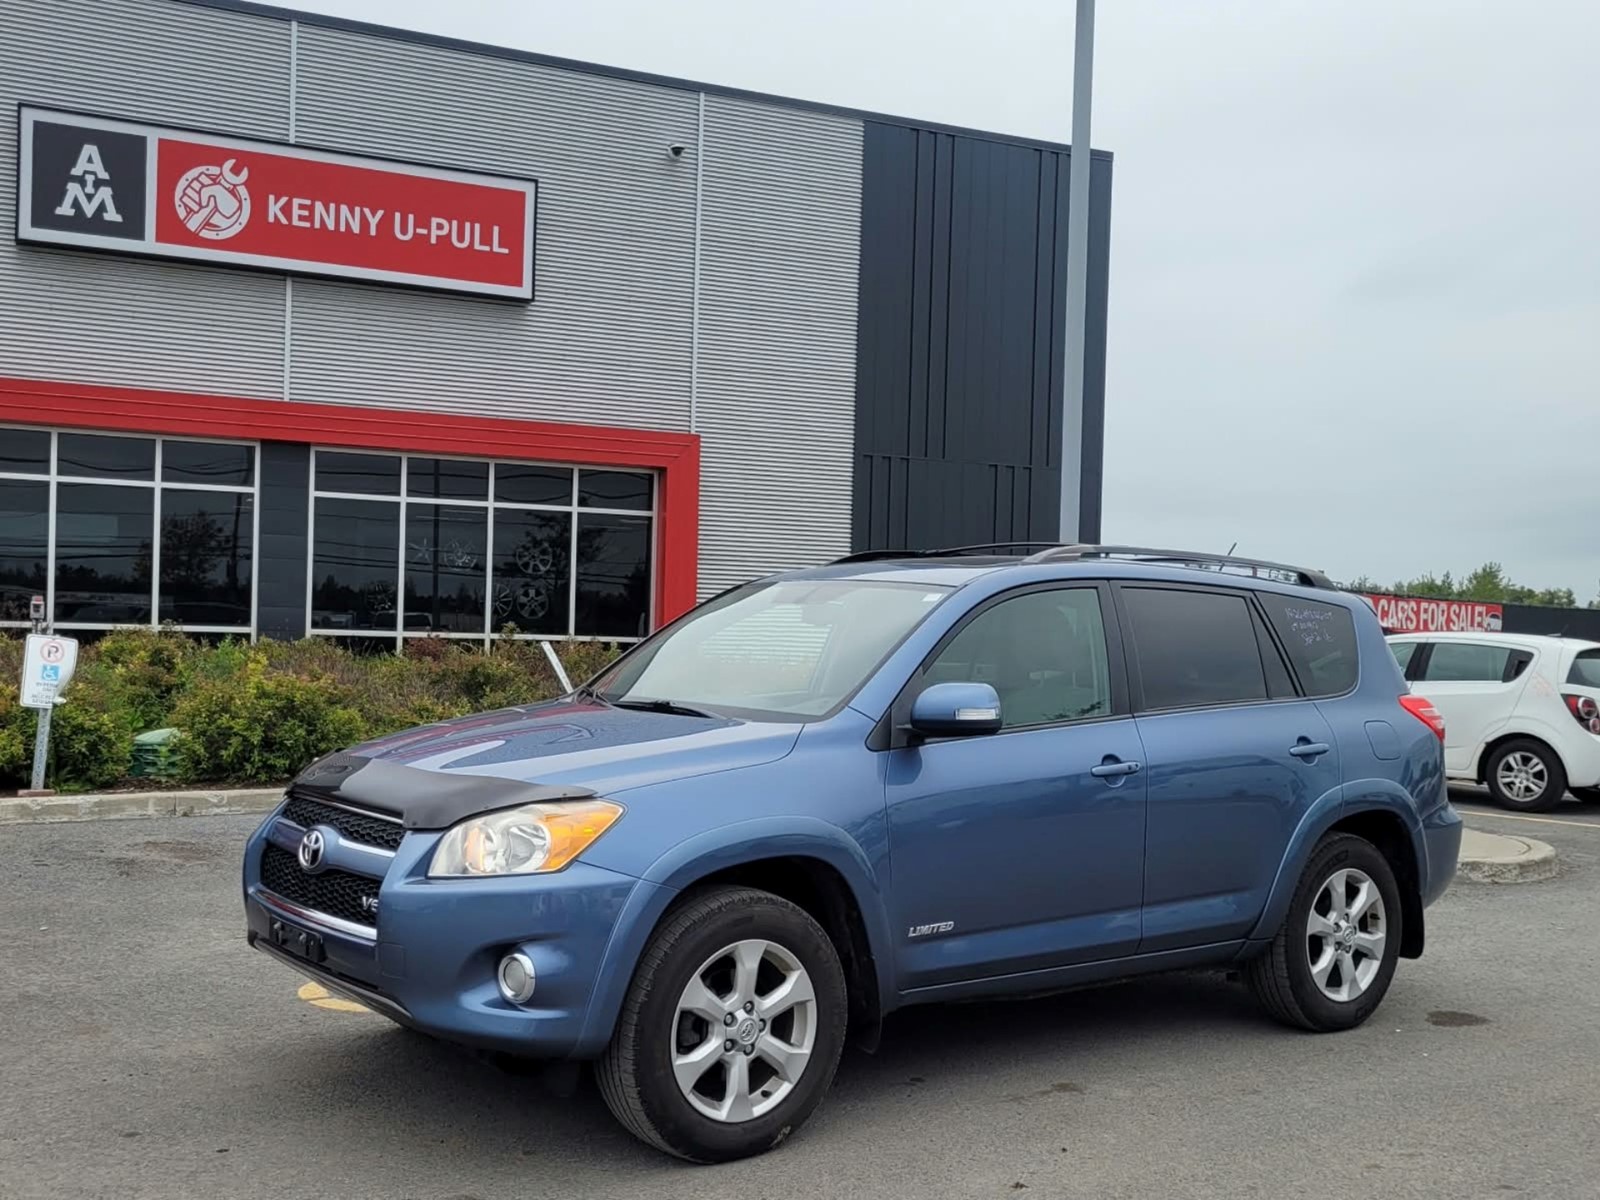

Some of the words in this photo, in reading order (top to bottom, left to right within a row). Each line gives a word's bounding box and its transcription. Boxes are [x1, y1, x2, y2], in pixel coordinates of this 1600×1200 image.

[267, 194, 385, 237] KENNY
[394, 211, 510, 254] U-PULL
[1377, 598, 1417, 630] CARS
[1420, 602, 1447, 631] FOR
[908, 921, 954, 937] LIMITED
